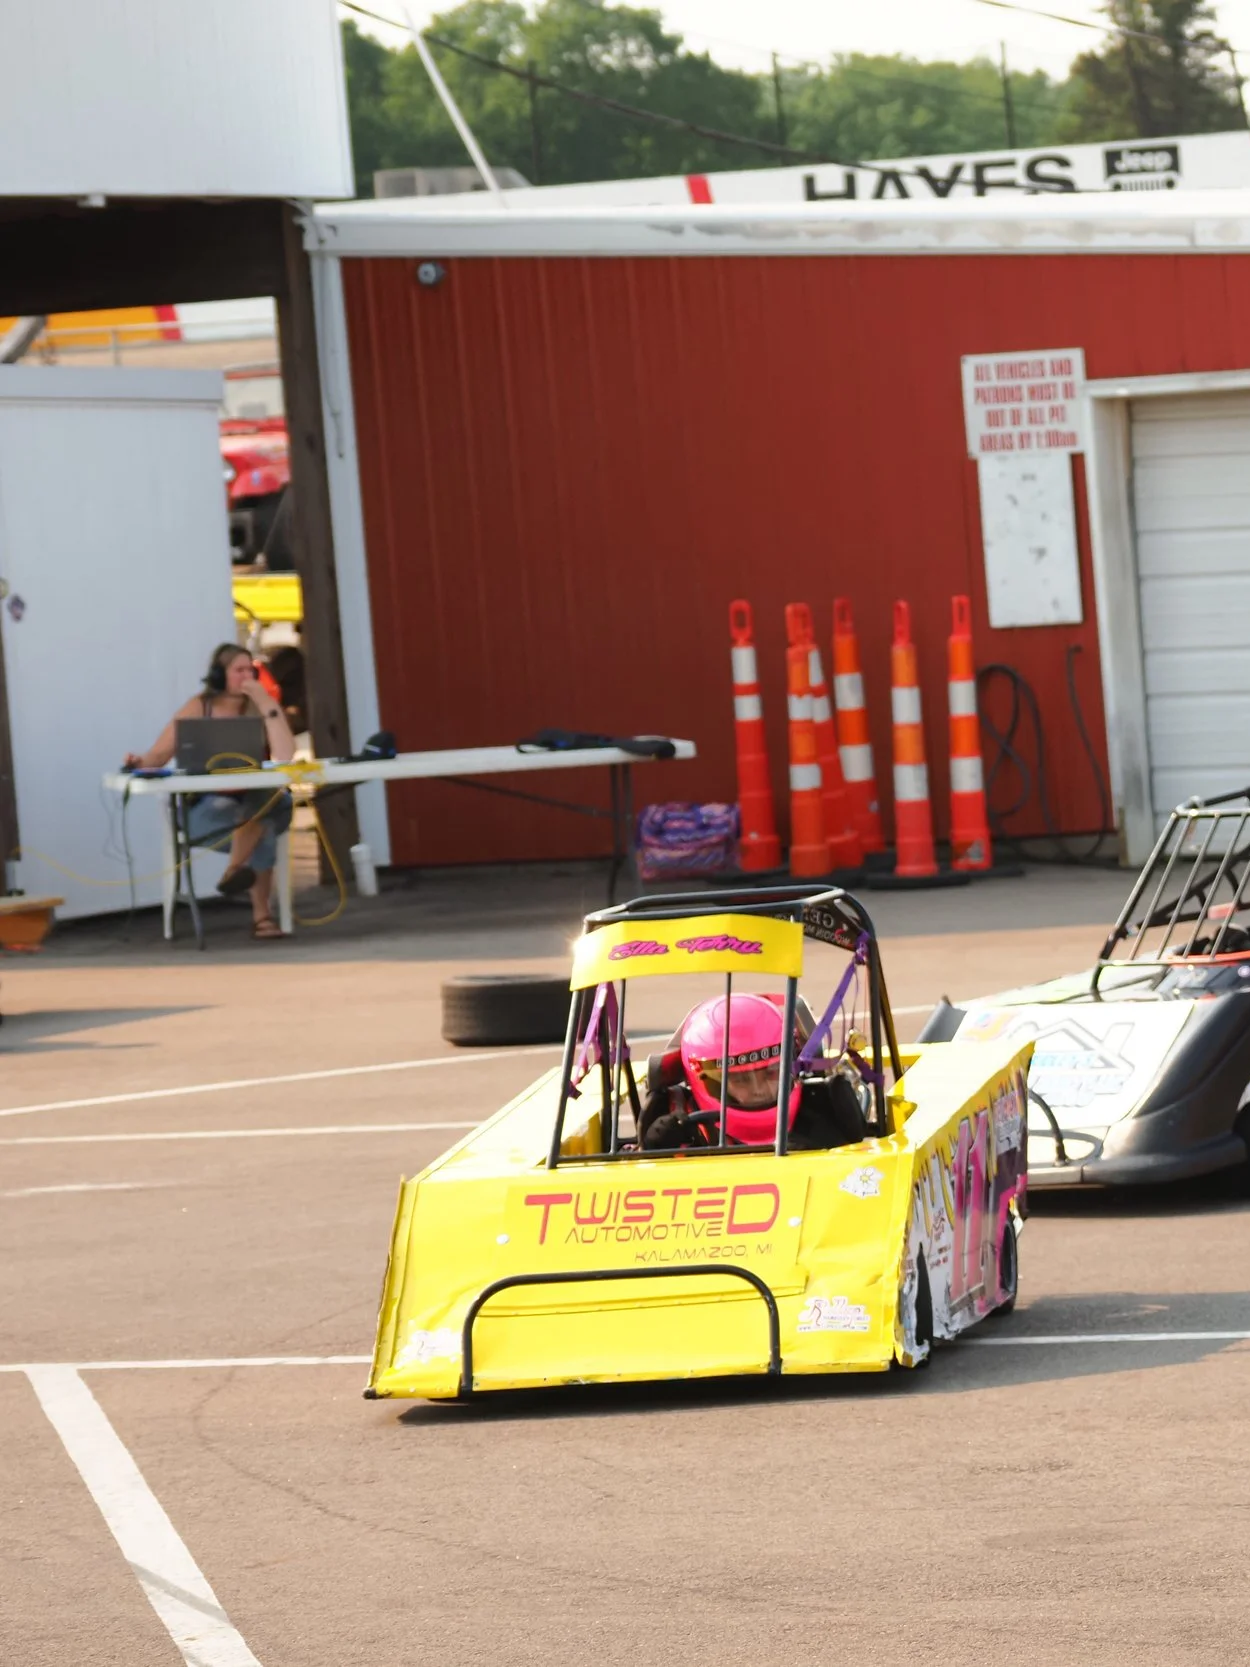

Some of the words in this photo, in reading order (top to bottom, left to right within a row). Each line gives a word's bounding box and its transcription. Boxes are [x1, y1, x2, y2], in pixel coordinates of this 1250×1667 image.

[1114, 149, 1173, 173] Jeep
[994, 361, 1045, 380] VEHICLES
[1049, 358, 1072, 376] AND
[986, 409, 1005, 428] OUT
[1010, 407, 1021, 426] OF
[1027, 407, 1046, 425] ALL
[524, 1183, 780, 1246] TWISTED
[564, 1220, 724, 1244] AUTOMOTIVE
[634, 1245, 749, 1263] KALAMAZOO,
[755, 1243, 773, 1256] MI
